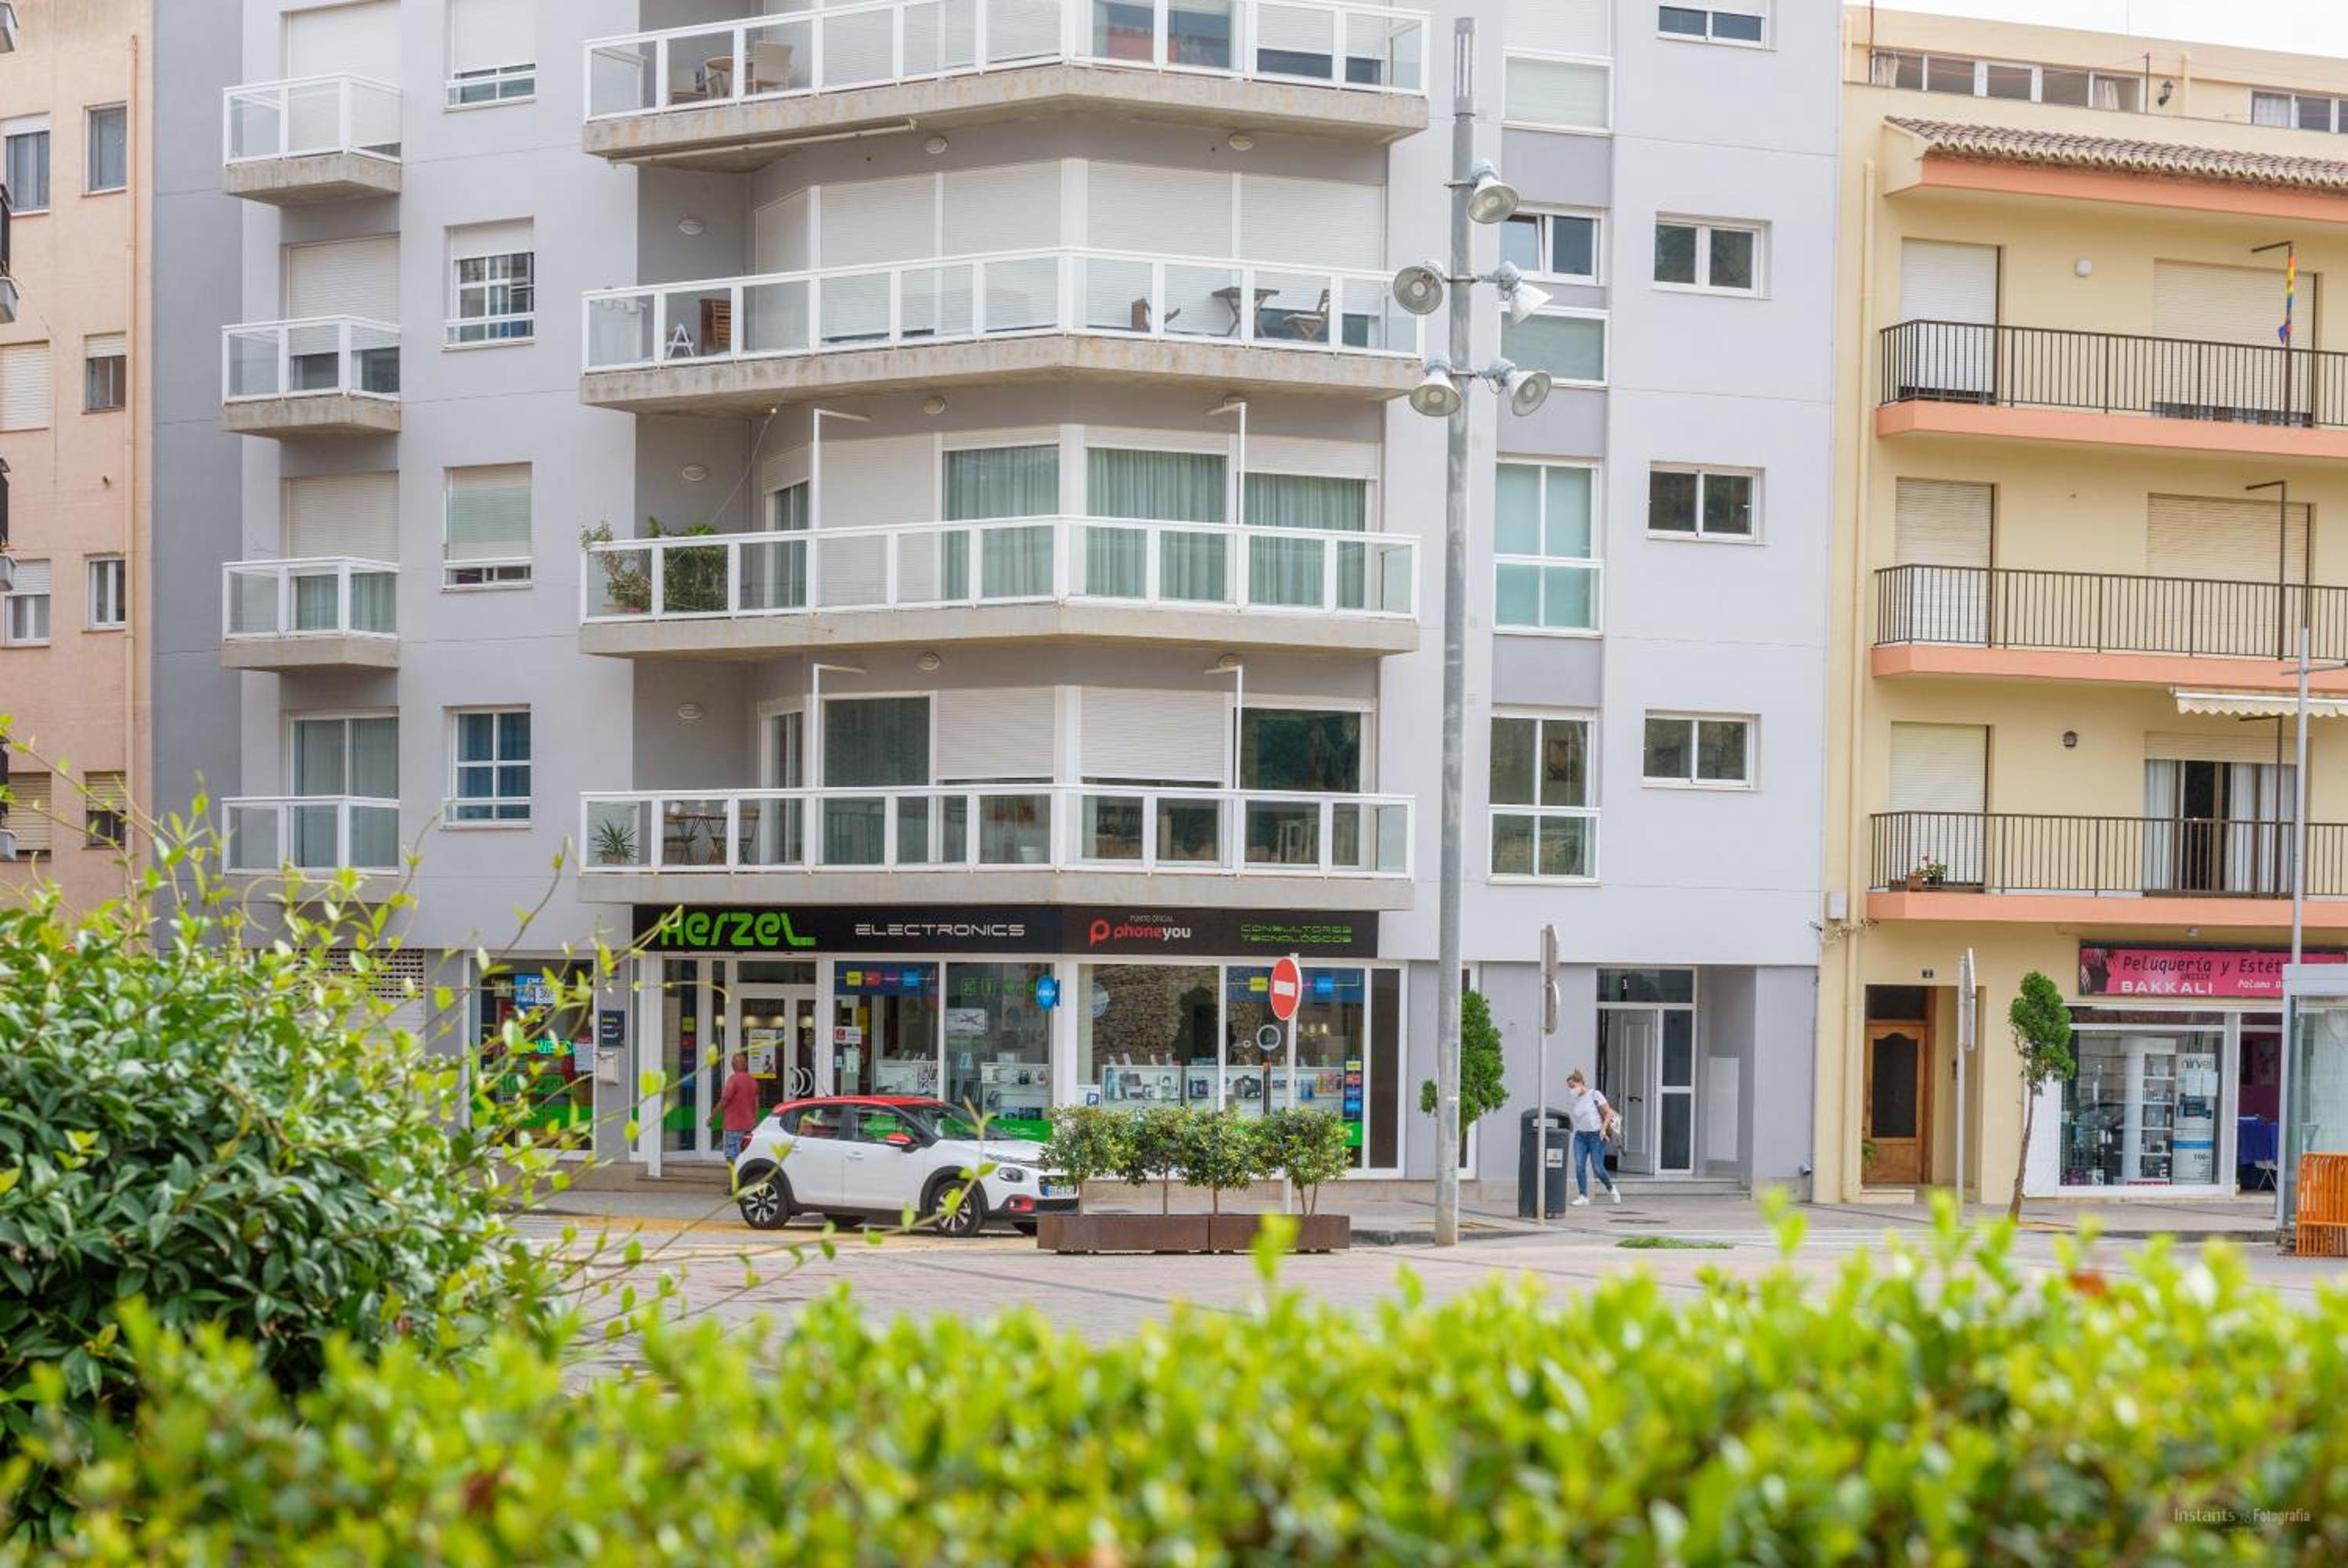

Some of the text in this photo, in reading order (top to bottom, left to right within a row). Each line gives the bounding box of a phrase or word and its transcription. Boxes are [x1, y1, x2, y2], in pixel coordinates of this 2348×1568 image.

[855, 924, 1025, 936] ELECTRONICS
[1114, 923, 1190, 941] phoneyou
[2220, 961, 2230, 975] y
[2238, 958, 2292, 973] Estét
[2122, 980, 2213, 994] BAKKALI
